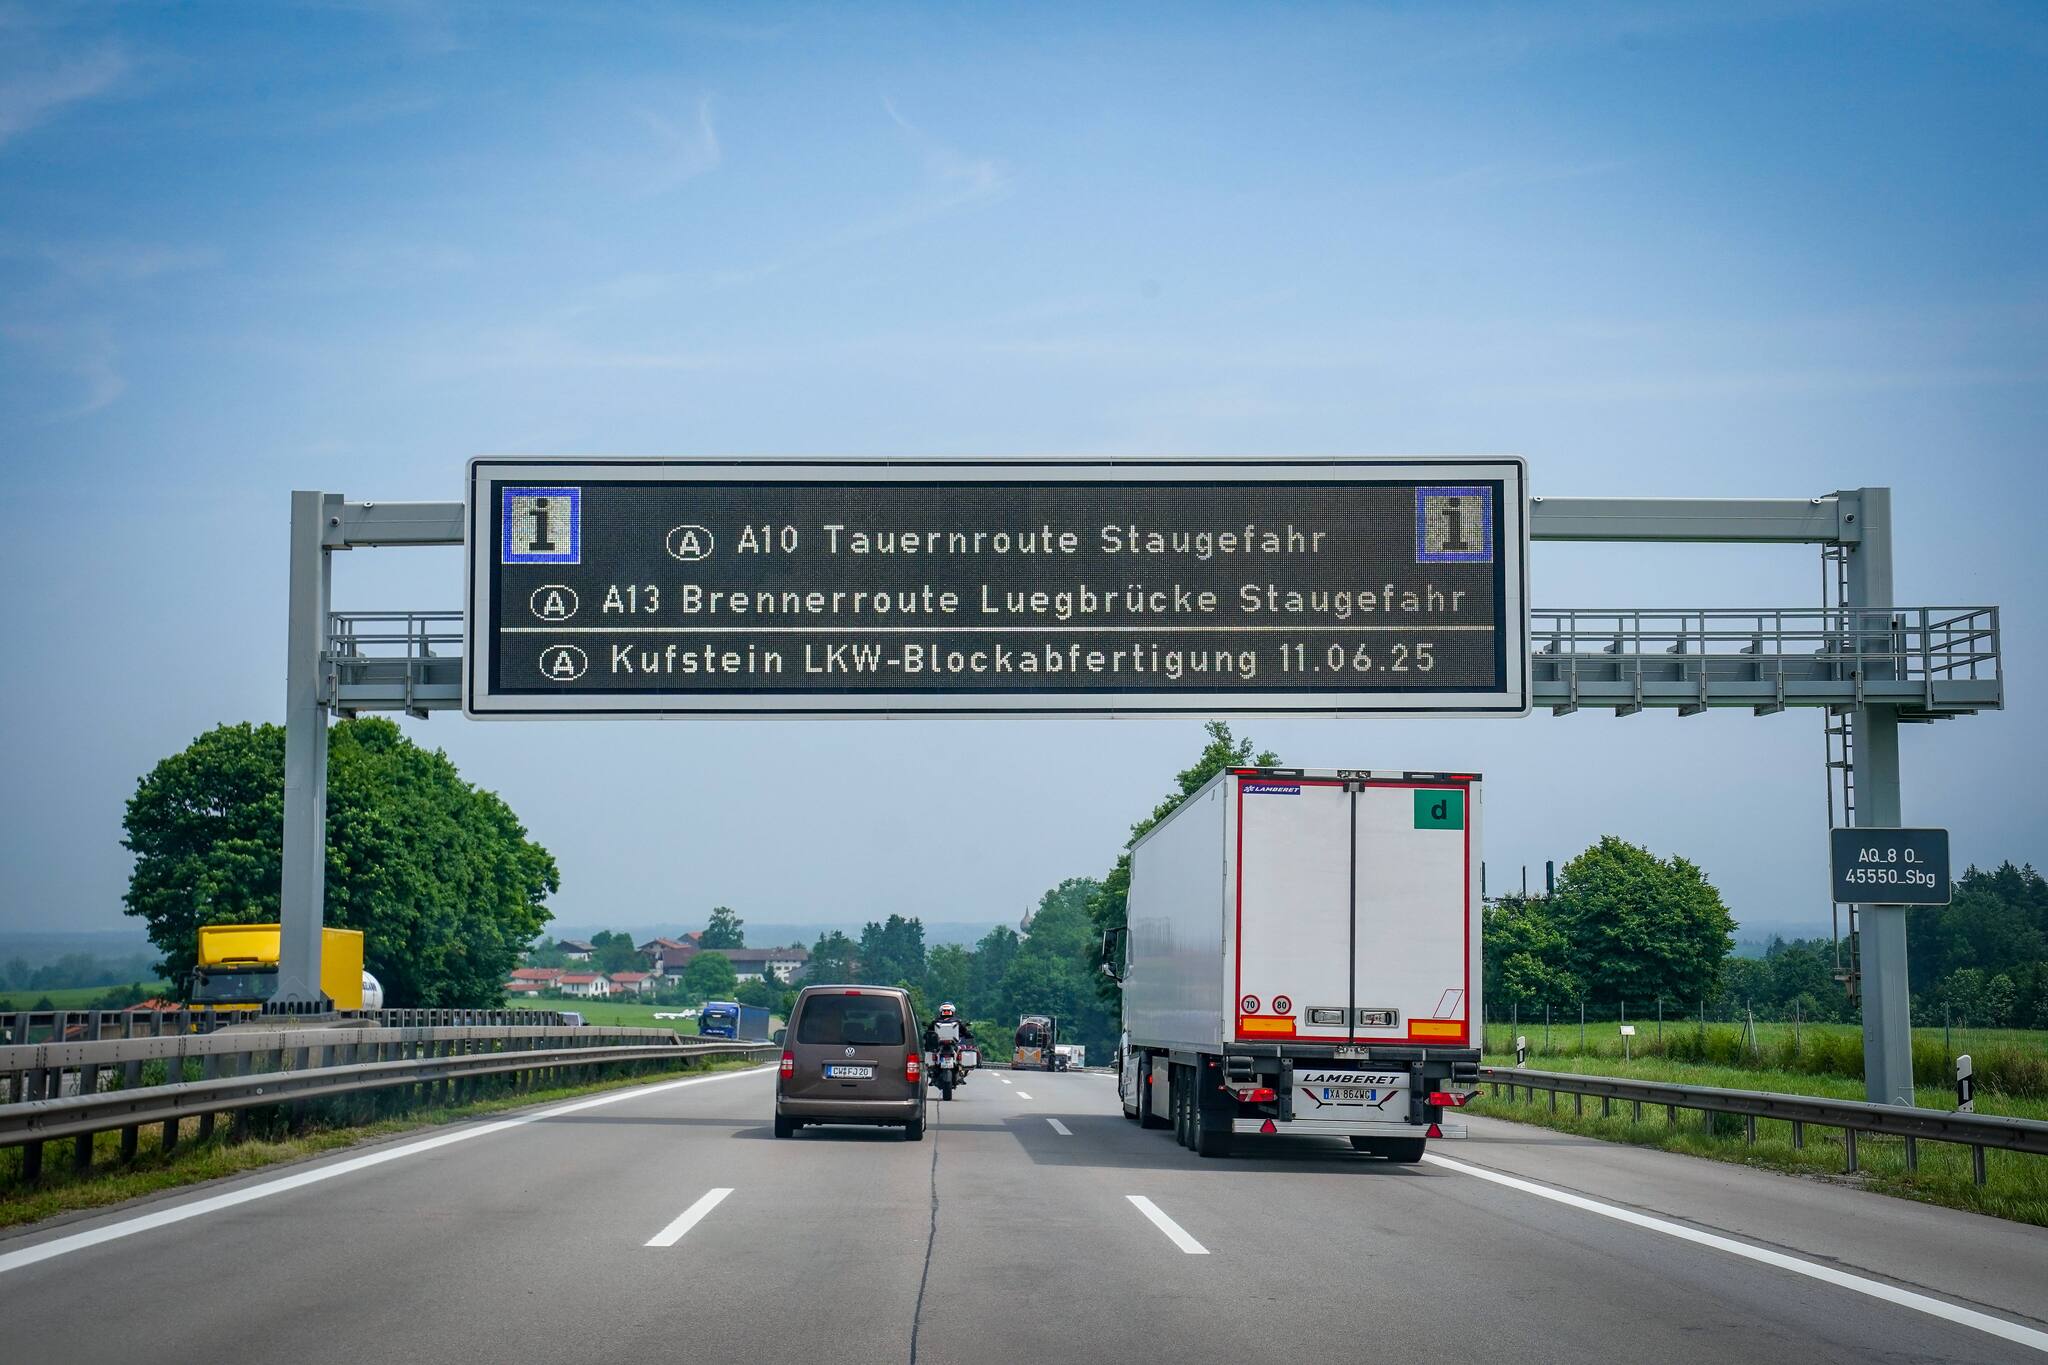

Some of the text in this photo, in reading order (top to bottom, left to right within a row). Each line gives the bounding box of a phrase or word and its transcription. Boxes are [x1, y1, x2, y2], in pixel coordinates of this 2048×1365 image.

[738, 525, 798, 554] A10
[823, 525, 1078, 554] Tauernroute
[1101, 524, 1326, 560] Staugefahr
[603, 584, 660, 614] A13
[683, 584, 959, 614] Brennerroute
[982, 584, 1217, 621] Luegbrücke
[1240, 584, 1466, 619] Staugefahr
[612, 644, 783, 674] Kufstein
[805, 643, 1257, 680] LKW-Blockabfertigung
[1280, 643, 1434, 672] 11.06.25
[1254, 785, 1300, 793] LAMBERET
[1431, 800, 1447, 820] d
[1845, 868, 1936, 888] 45550_Sbg
[1246, 1000, 1255, 1009] 70
[1277, 1001, 1287, 1010] 80
[1303, 1073, 1400, 1085] LAMBERET
